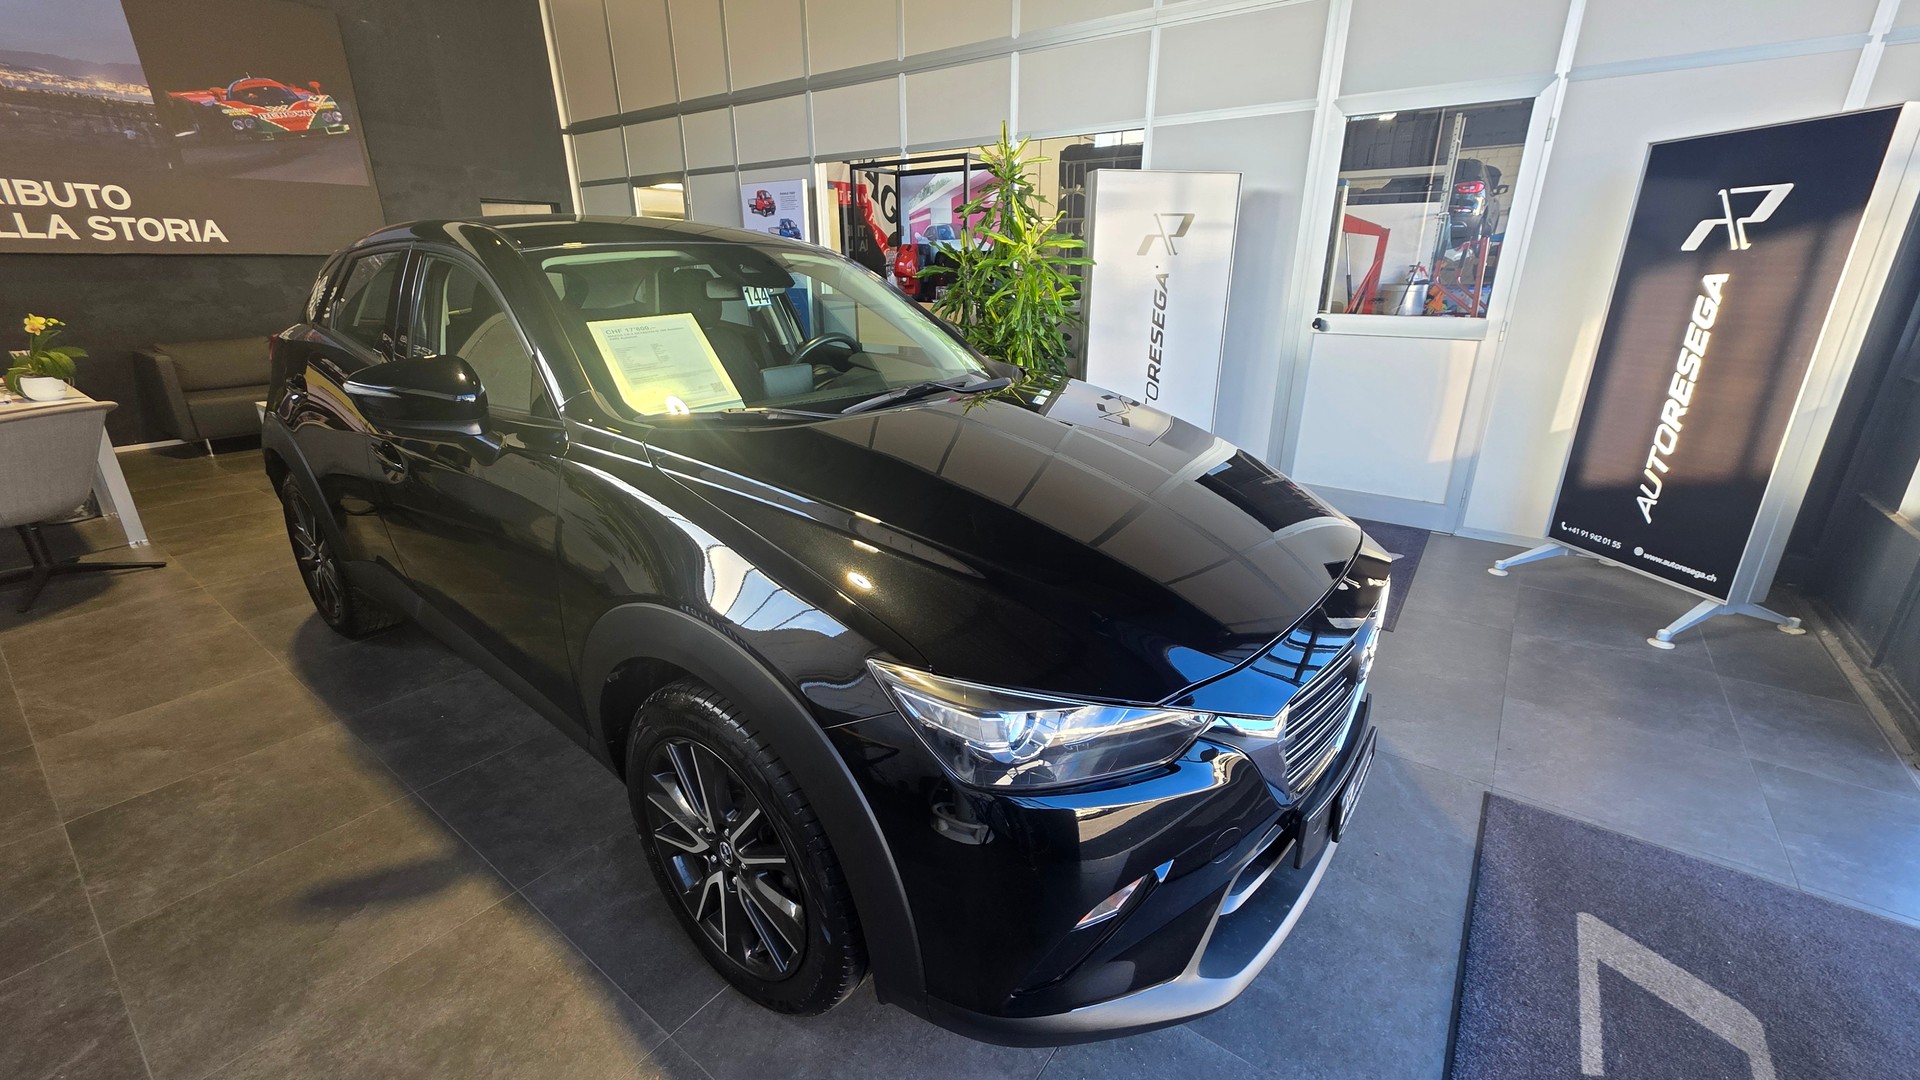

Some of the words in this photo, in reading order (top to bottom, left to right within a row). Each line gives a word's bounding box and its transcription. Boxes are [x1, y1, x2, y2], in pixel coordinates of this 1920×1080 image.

[0, 178, 132, 210] IBUTO
[87, 215, 229, 243] STORIA
[745, 287, 769, 305] 144
[1144, 273, 1170, 404] ORESEGA
[1634, 272, 1729, 524] AUTORESEGA
[1580, 529, 1589, 538] 91
[1602, 537, 1611, 546] 01
[1612, 540, 1622, 550] 55
[1643, 552, 1718, 583] www.autoresega.ch
